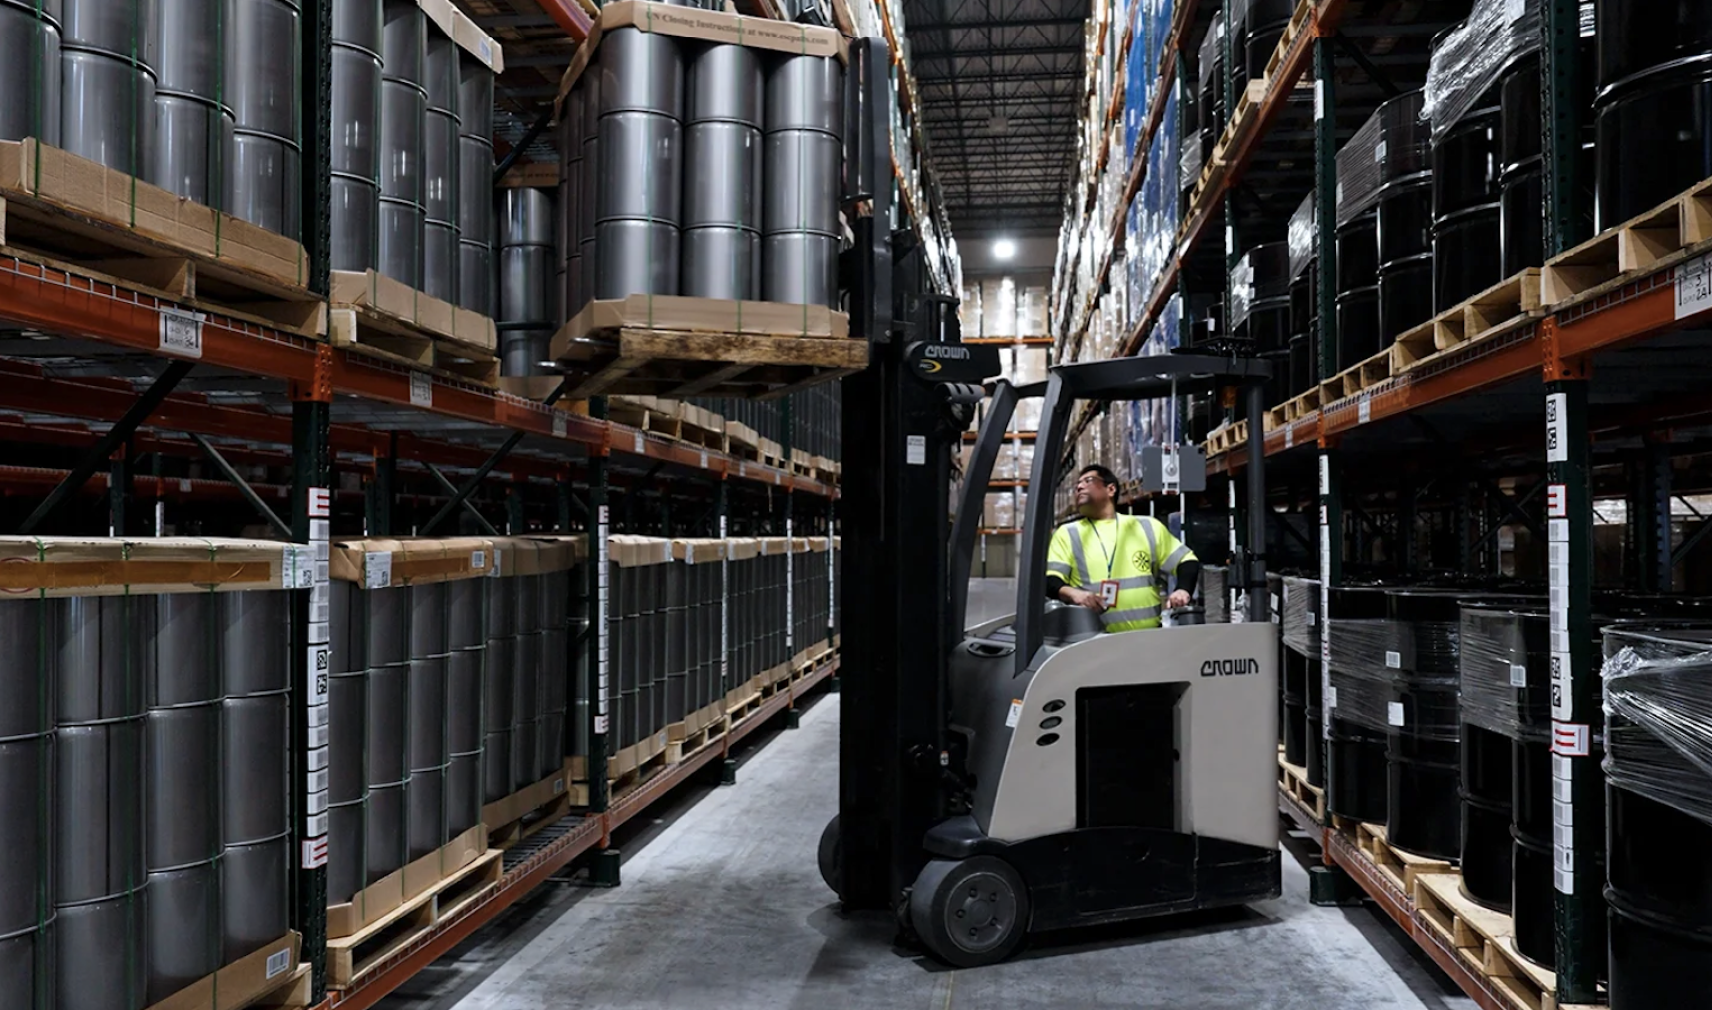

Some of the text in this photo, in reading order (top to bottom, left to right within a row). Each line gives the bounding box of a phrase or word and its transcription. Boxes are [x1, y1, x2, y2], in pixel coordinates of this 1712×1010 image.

[662, 13, 695, 28] Closing
[696, 19, 746, 34] Instructions
[748, 28, 756, 36] at
[925, 345, 970, 360] CROWN
[1200, 658, 1259, 677] CROWN
